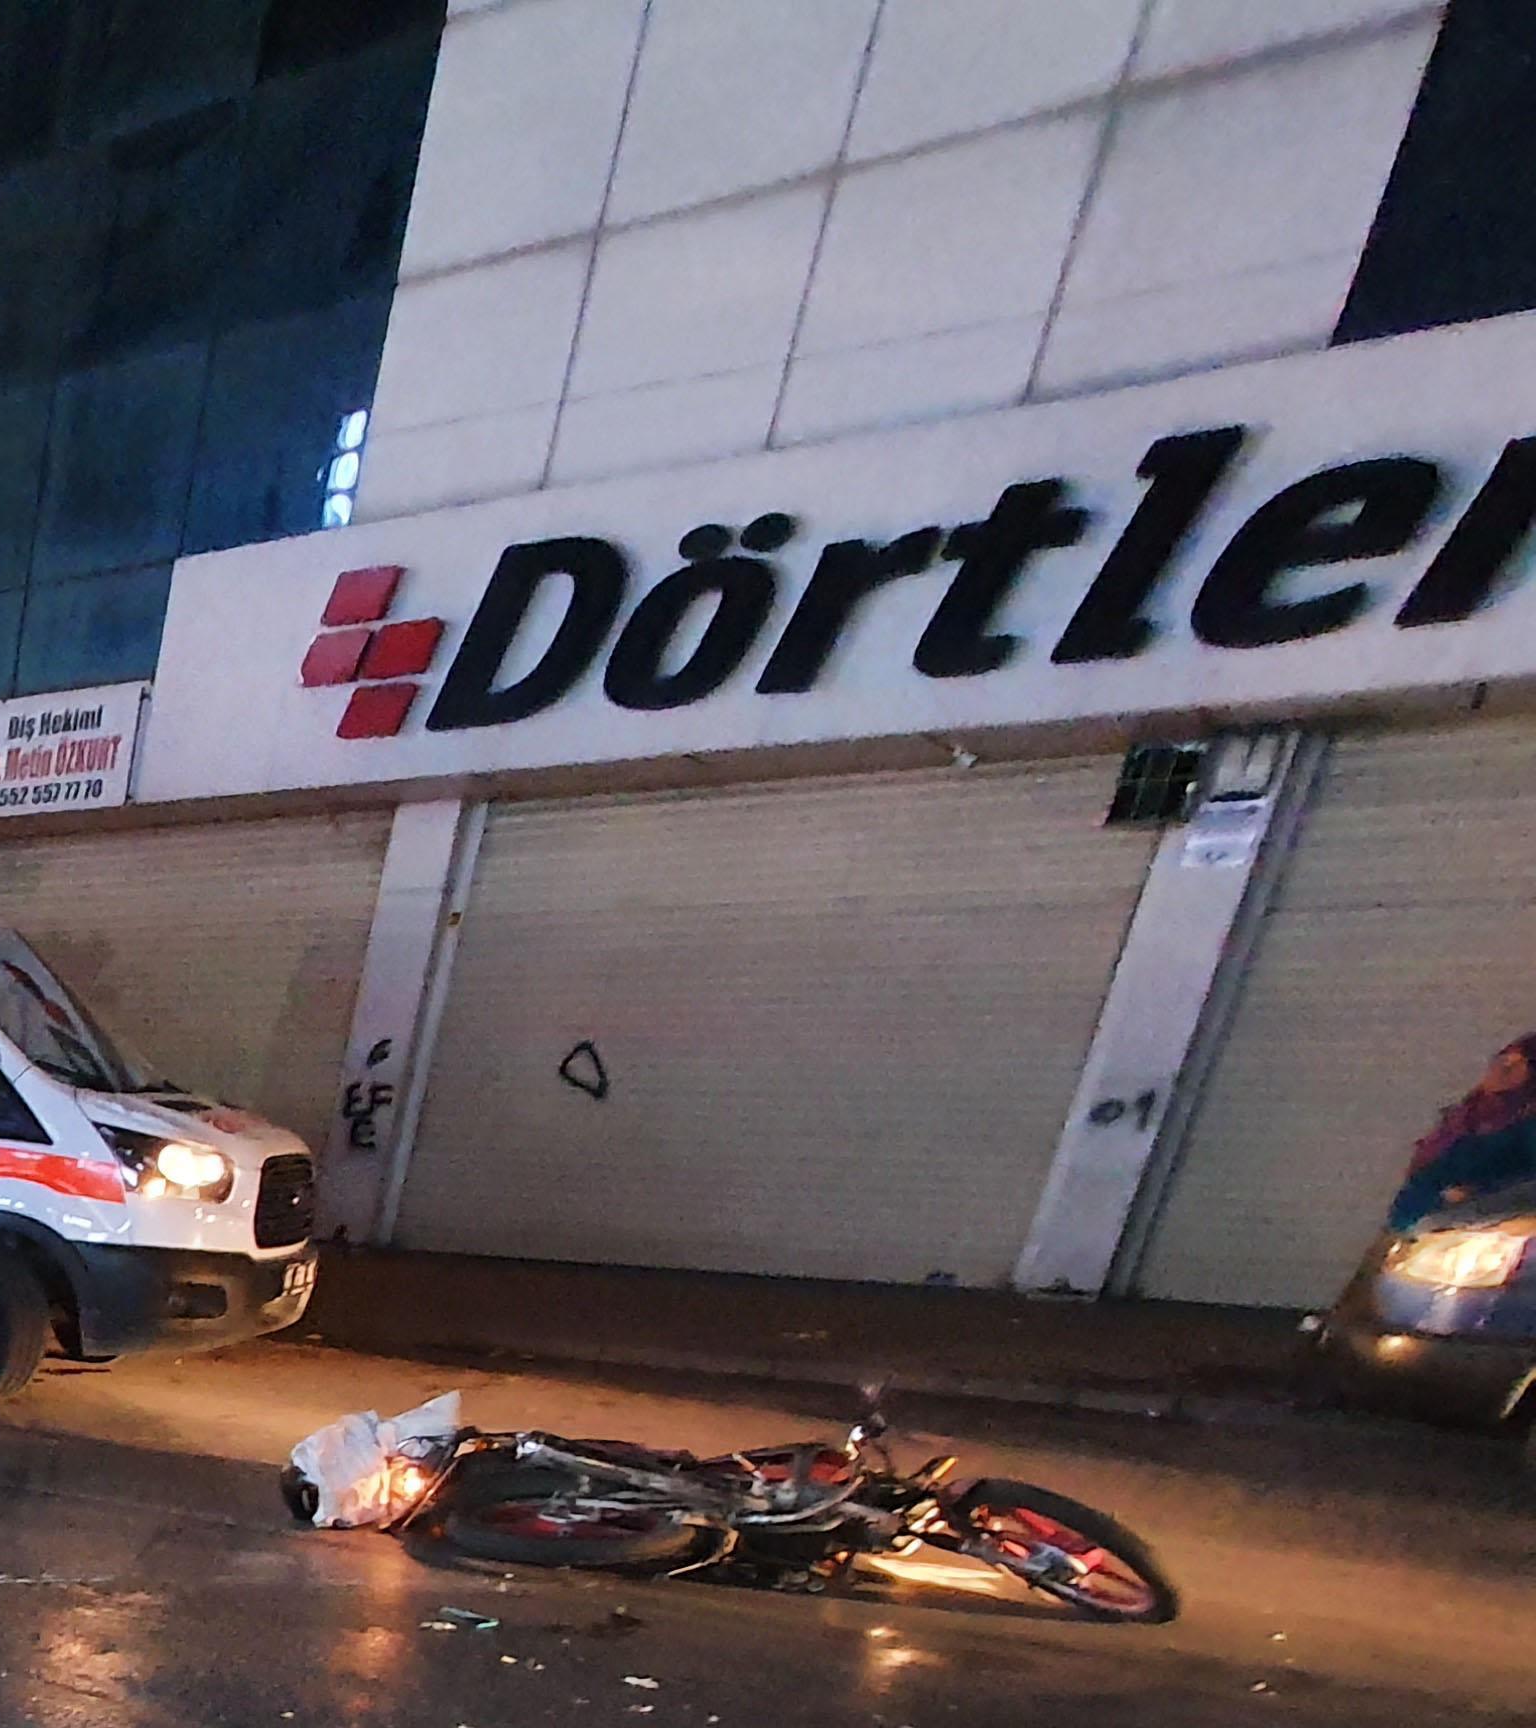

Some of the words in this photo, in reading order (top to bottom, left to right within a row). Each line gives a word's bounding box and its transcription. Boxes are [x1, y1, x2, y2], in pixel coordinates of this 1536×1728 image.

[7, 714, 36, 742] Diş
[39, 705, 103, 736] Hekimi
[4, 744, 53, 781] Metin
[54, 735, 122, 777] ÖZKURT
